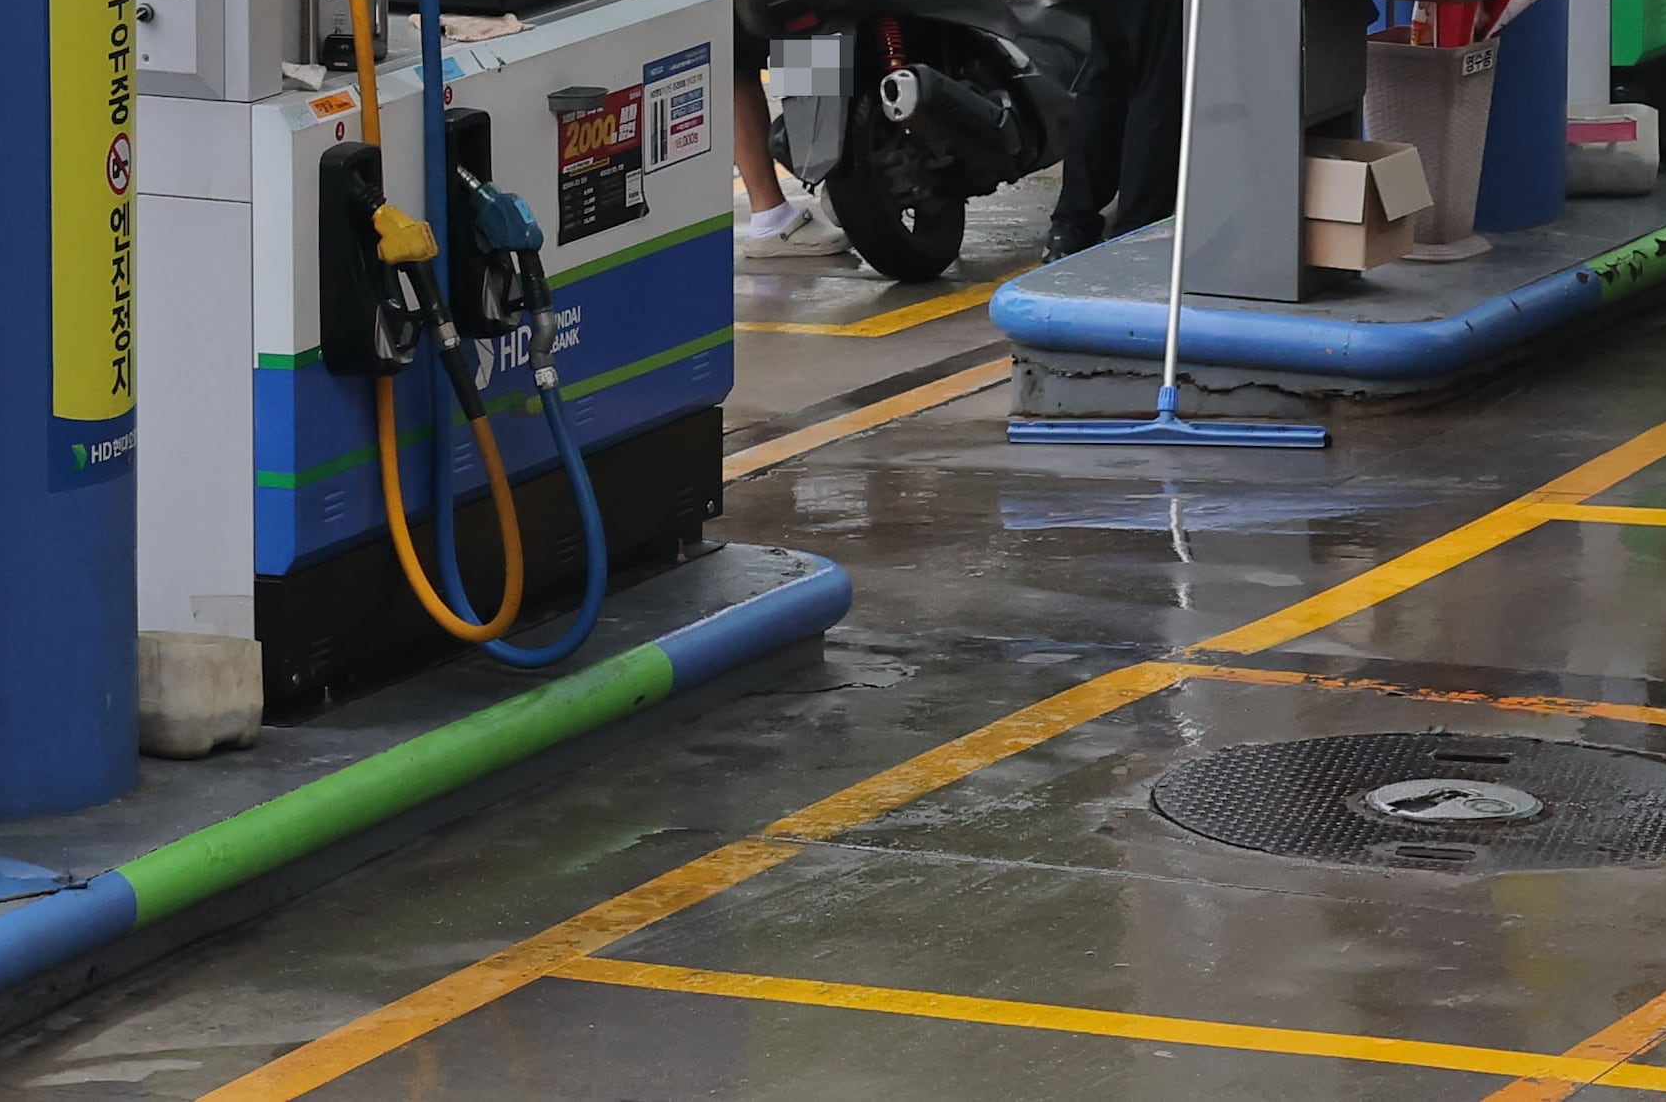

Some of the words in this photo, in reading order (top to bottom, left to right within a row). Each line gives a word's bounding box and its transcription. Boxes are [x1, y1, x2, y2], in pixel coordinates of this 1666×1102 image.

[1465, 49, 1492, 73] 영수증
[108, 203, 132, 398] 엔진정지
[499, 324, 533, 372] HD
[553, 305, 582, 330] NDAI
[550, 327, 581, 355] BANK
